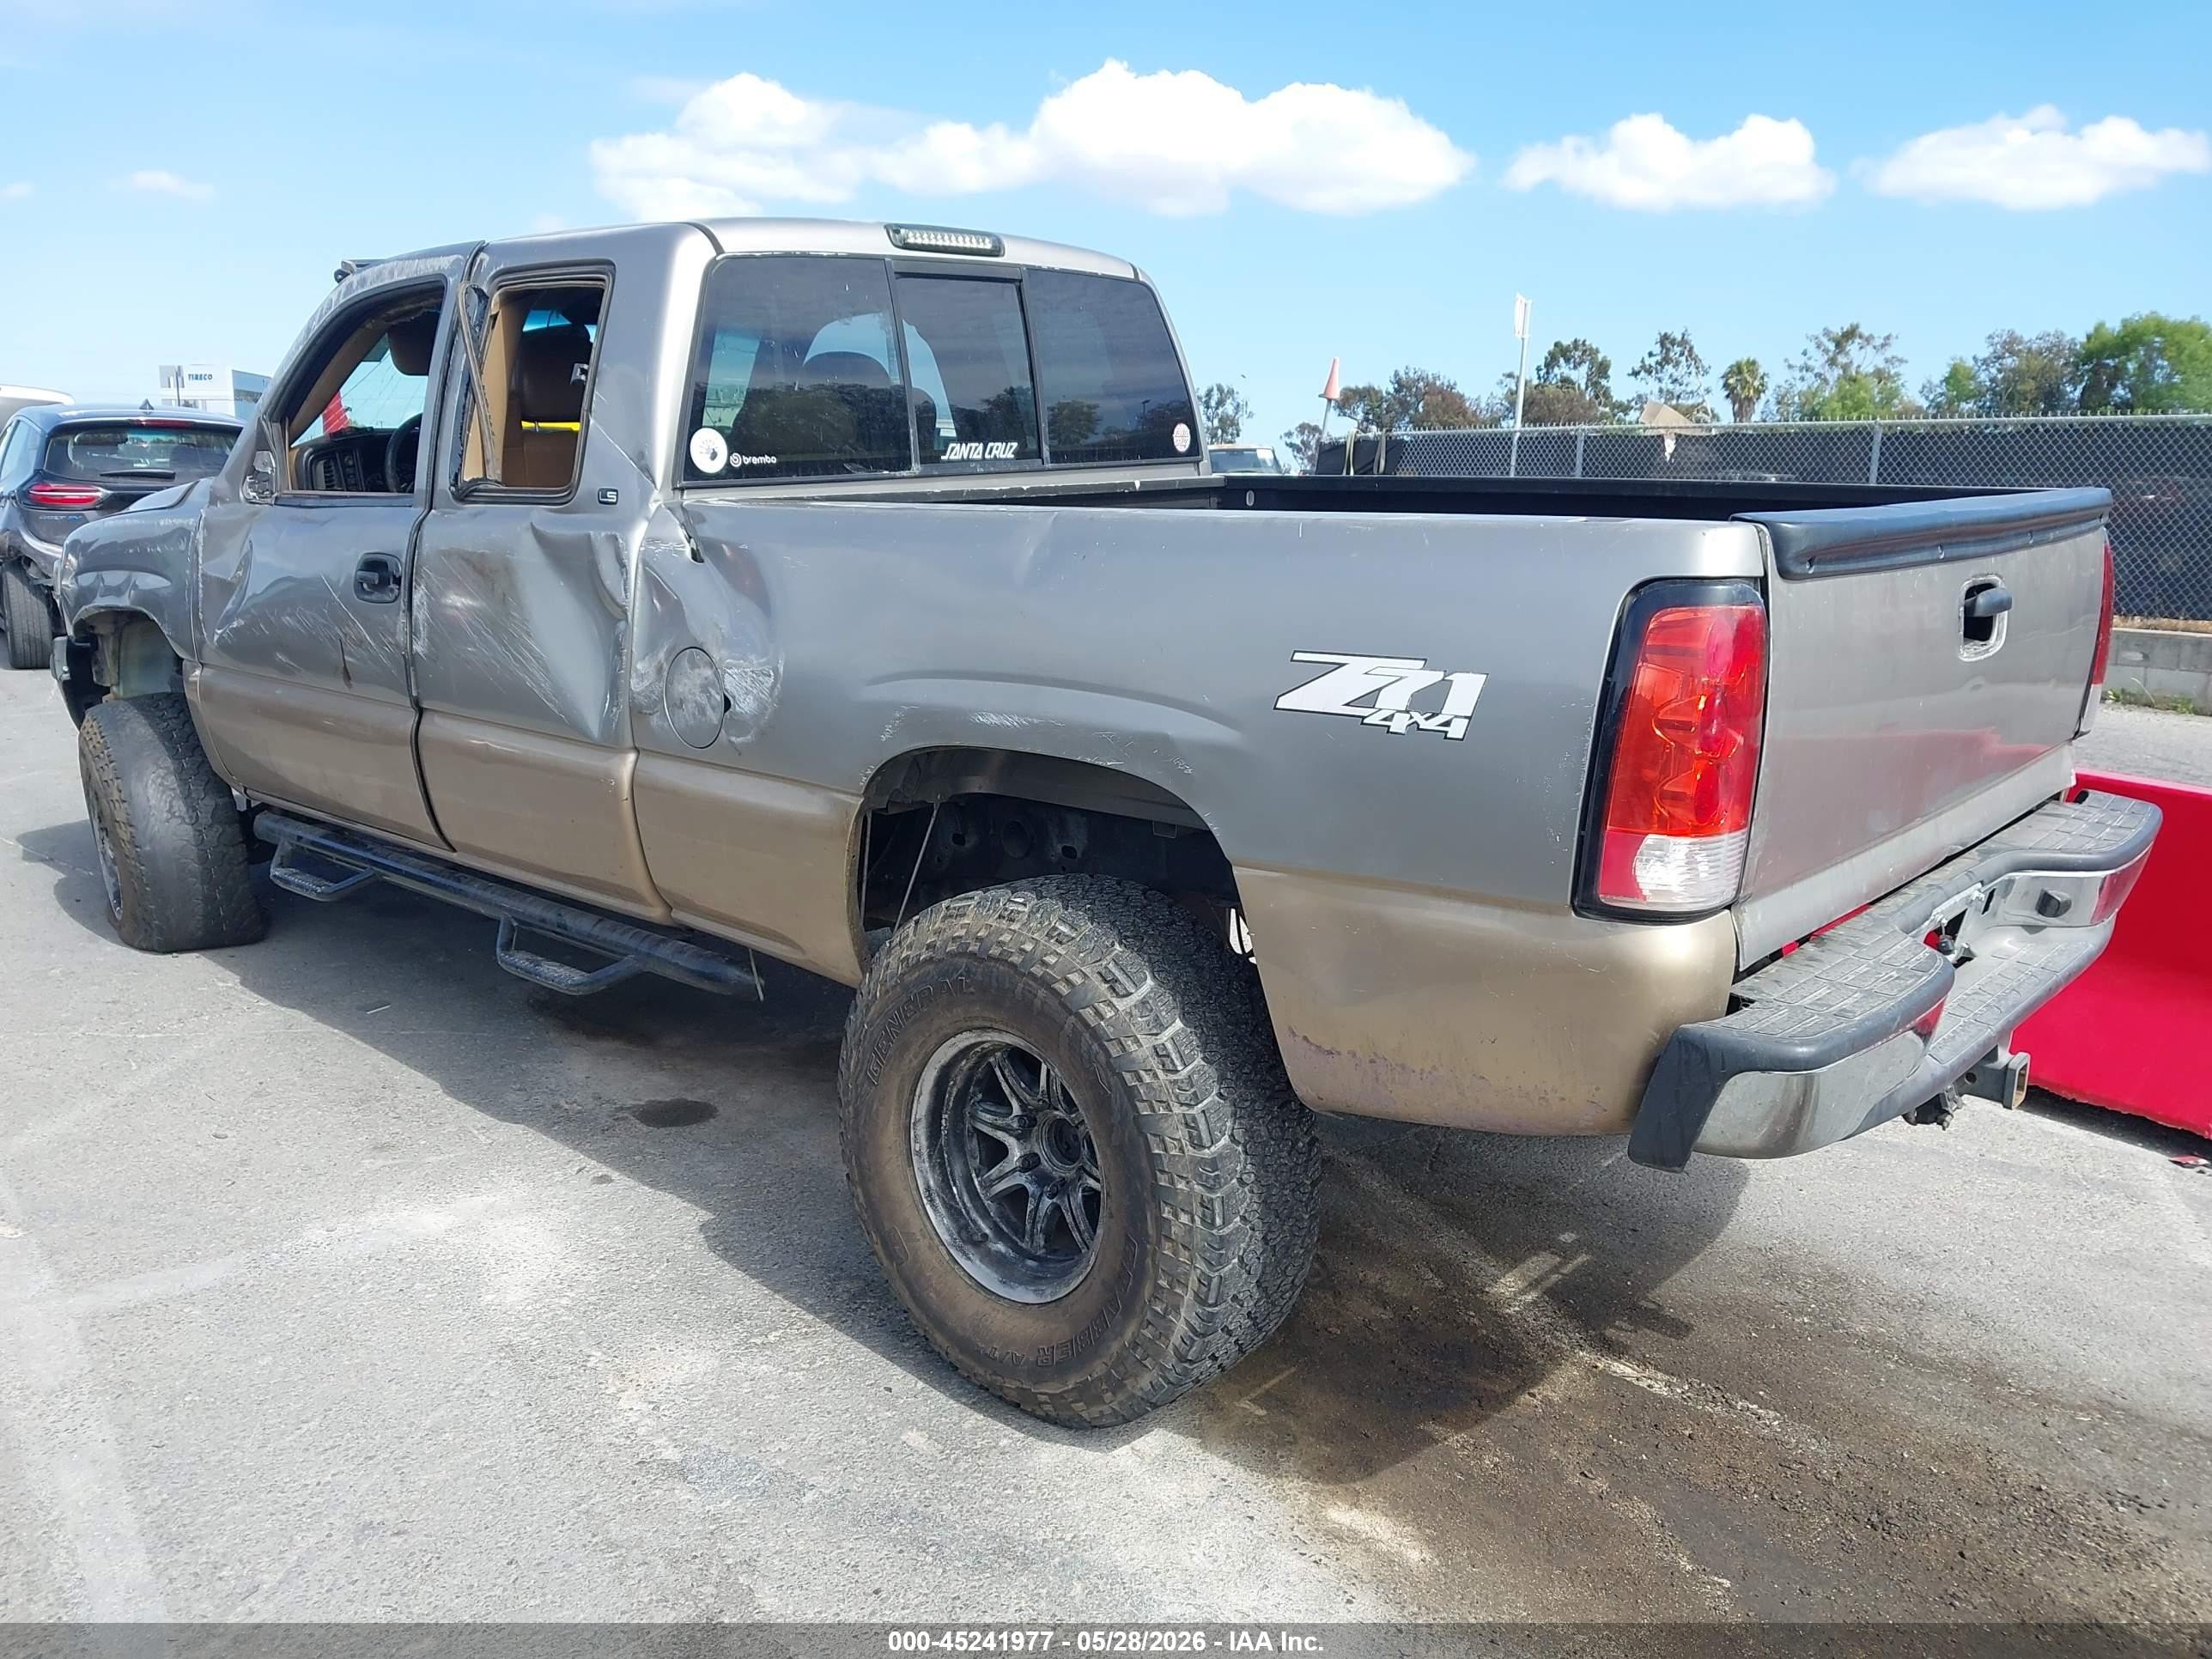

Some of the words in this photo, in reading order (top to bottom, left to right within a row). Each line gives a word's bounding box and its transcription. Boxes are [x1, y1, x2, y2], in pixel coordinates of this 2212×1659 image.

[187, 373, 214, 382] TIRECO
[940, 442, 984, 460] SANTA
[984, 441, 1018, 459] CRUZ
[742, 453, 777, 465] brembo
[599, 490, 617, 502] LS
[1273, 649, 1490, 720] Z71
[866, 975, 975, 1086] GENERAL
